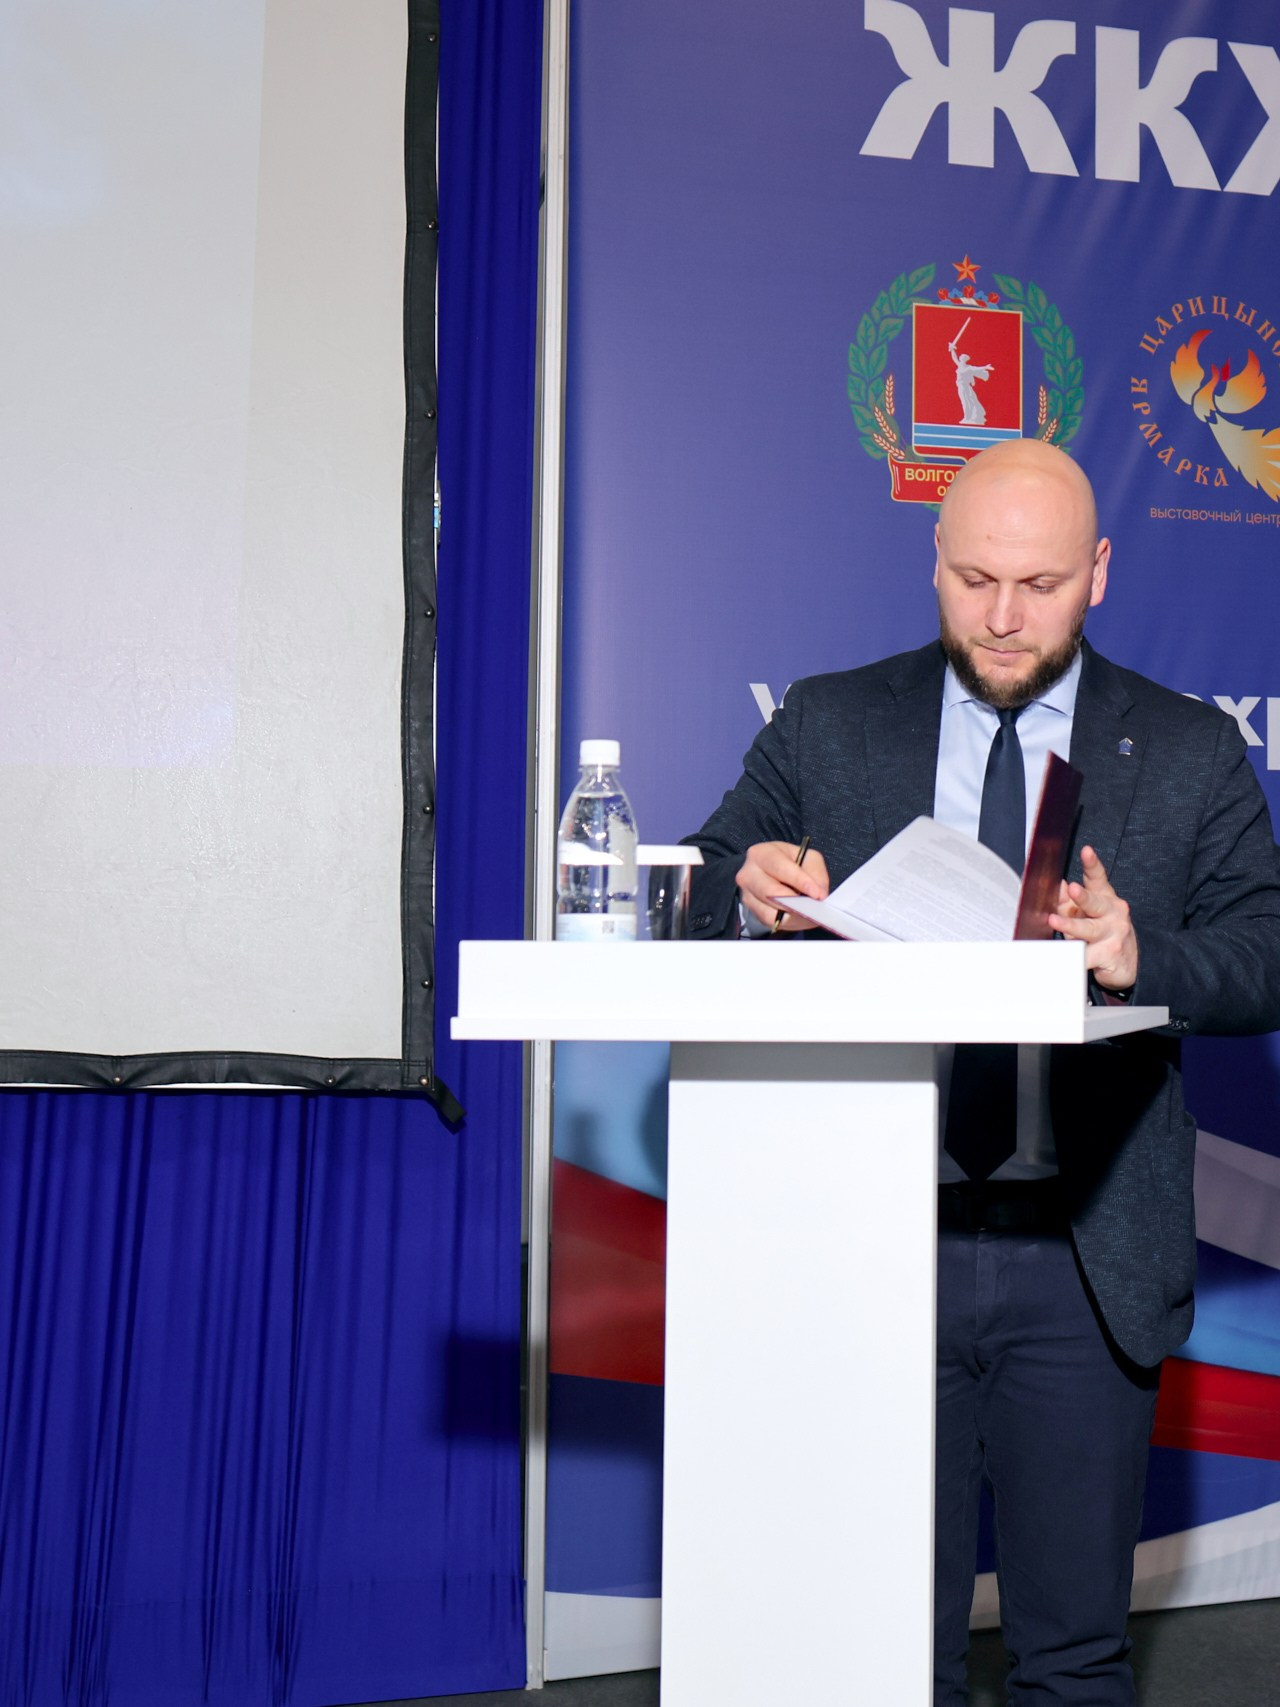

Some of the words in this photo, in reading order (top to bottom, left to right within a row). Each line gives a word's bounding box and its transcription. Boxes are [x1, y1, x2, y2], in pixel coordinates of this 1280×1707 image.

[1131, 377, 1229, 487] ЯРМАРКА
[905, 468, 960, 482] ВОЛГО
[1150, 507, 1241, 522] выставочный
